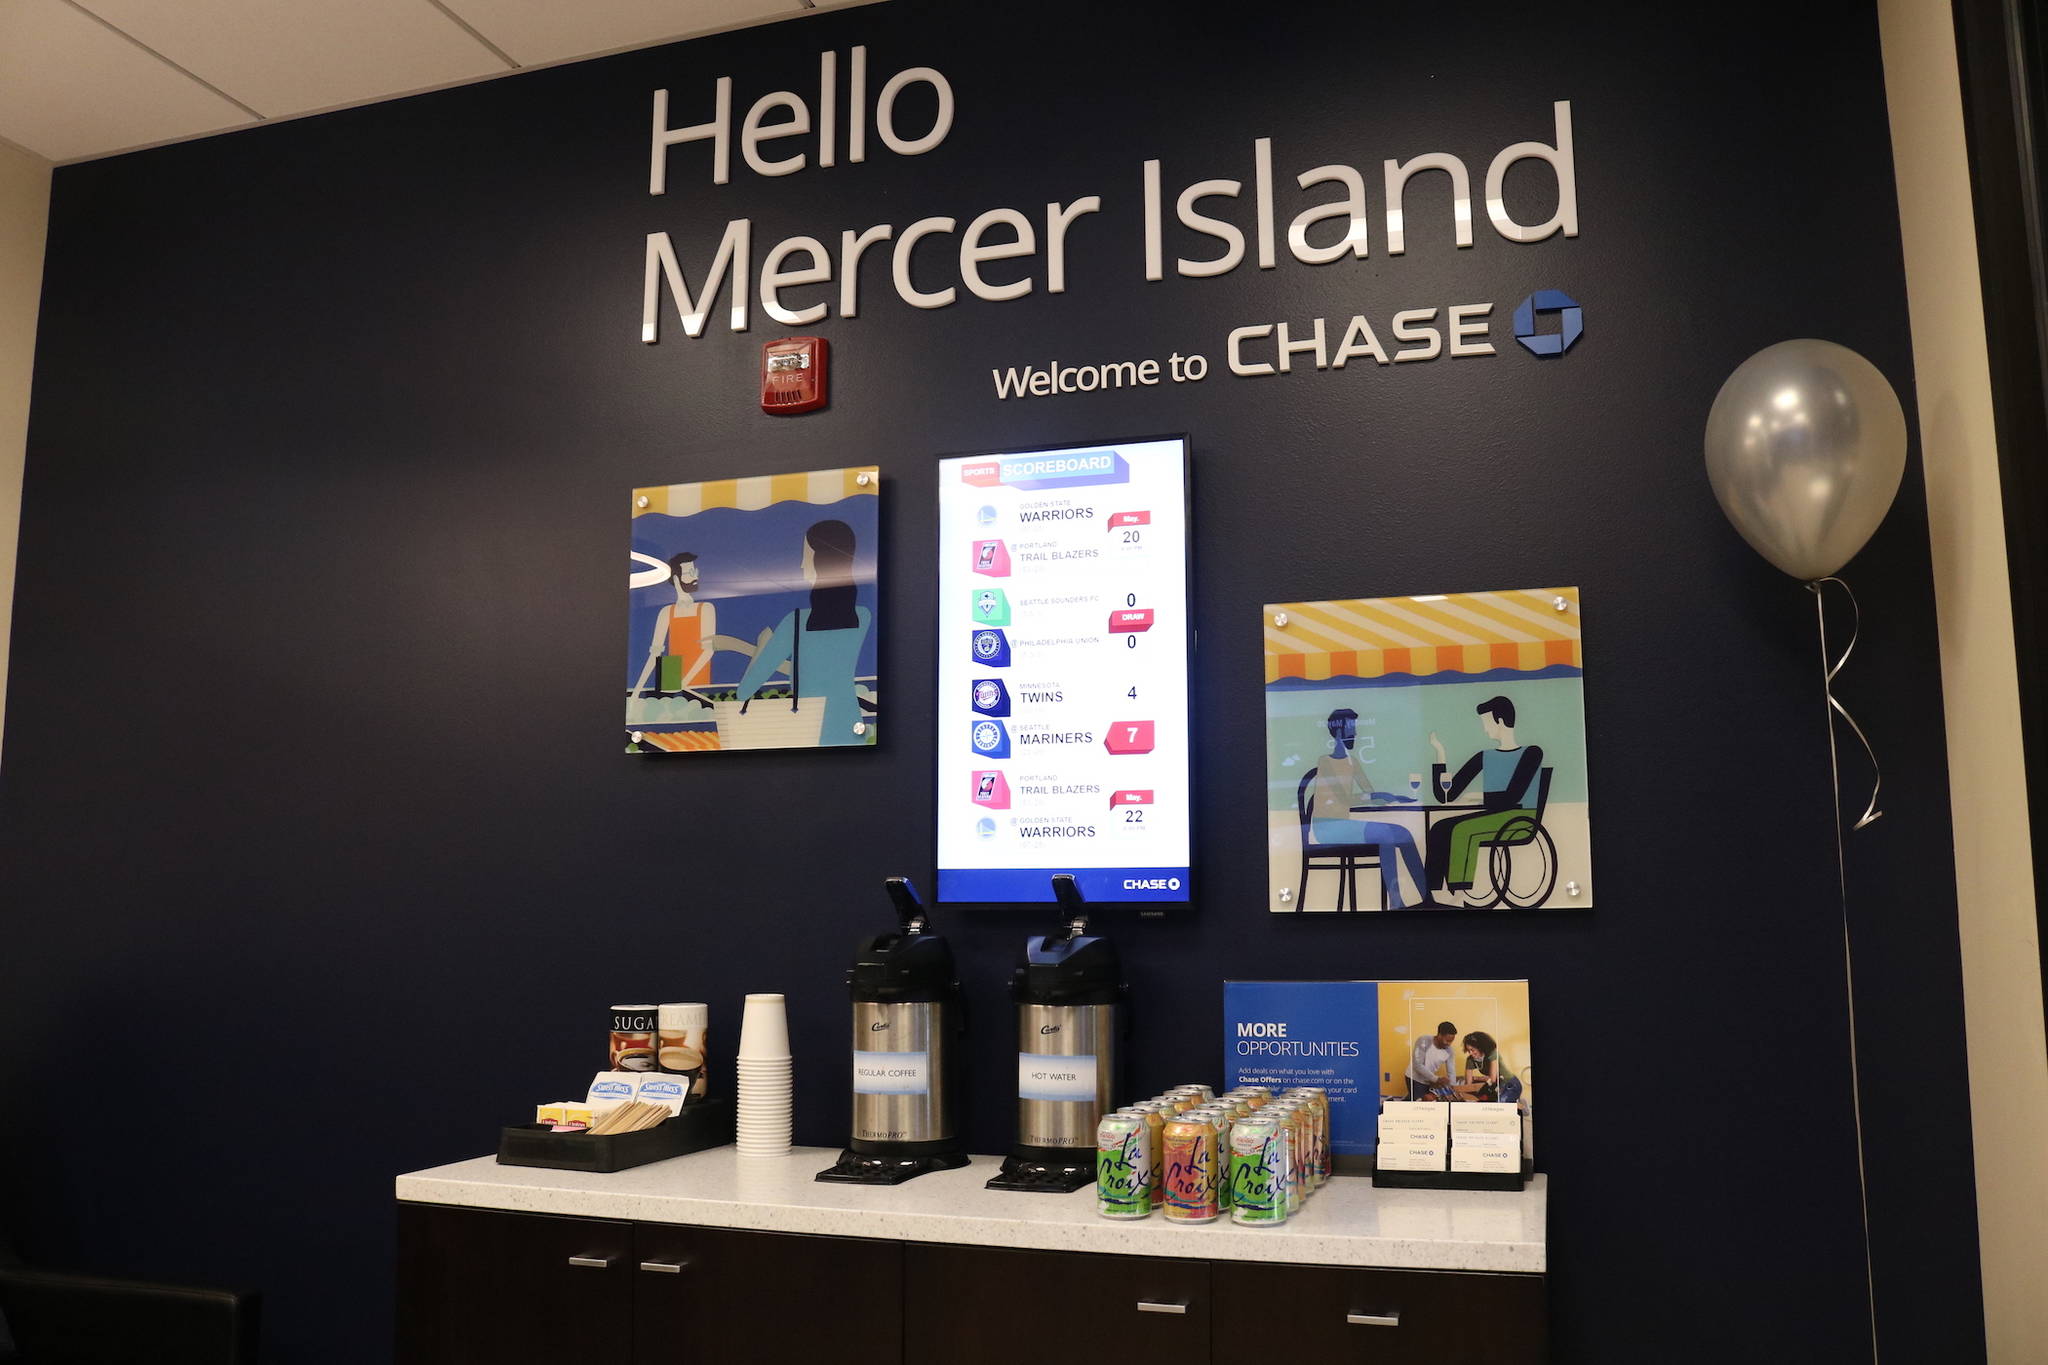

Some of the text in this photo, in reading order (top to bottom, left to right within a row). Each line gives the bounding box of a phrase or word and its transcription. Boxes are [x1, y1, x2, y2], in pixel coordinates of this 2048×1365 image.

[649, 45, 955, 196] Hello
[639, 99, 1579, 344] Mercer Island
[992, 302, 1496, 400] Welcome to CHASE
[773, 373, 804, 384] FIRE
[963, 455, 1112, 478] SPORTS SCOREBOARD
[1019, 501, 1049, 510] GOLDEN
[1019, 507, 1094, 523] WARRIORS
[1123, 530, 1140, 543] 20
[1019, 541, 1057, 550] PORTLAND
[1020, 549, 1099, 562] TRAIL BLAZERS
[1019, 598, 1049, 606] SEATTLE
[1050, 596, 1088, 605] SOUNDERS
[1127, 592, 1136, 607] 0
[1122, 612, 1145, 621] DRAW
[1019, 638, 1073, 648] PHILADELPHIA
[1075, 636, 1100, 645] UNION
[1127, 634, 1137, 649] 0
[1019, 681, 1060, 689] MINNESOTA
[1020, 691, 1063, 703] TWINS
[1127, 686, 1137, 700] 4
[1020, 732, 1093, 745] MARINERS
[1127, 727, 1138, 743] 7
[1020, 784, 1100, 795] TRAIL BLAZERS
[1126, 810, 1143, 823] 22
[1020, 826, 1095, 838] WARRIORS
[1123, 879, 1168, 890] CHASE
[614, 1015, 657, 1030] SUGA
[1237, 1022, 1287, 1037] MORE
[1237, 1040, 1360, 1057] OPPORTUNITIES
[858, 1067, 916, 1078] REGULAR COFFEE
[1032, 1072, 1077, 1081] HOT WATER
[1279, 1067, 1294, 1075] what
[1307, 1067, 1320, 1075] love
[1321, 1067, 1335, 1075] with
[1114, 1132, 1143, 1171] La
[1184, 1135, 1211, 1175] La
[1253, 1136, 1280, 1176] La
[1097, 1158, 1149, 1197] Croix
[1165, 1162, 1217, 1200] Croix
[1232, 1163, 1287, 1202] Croix
